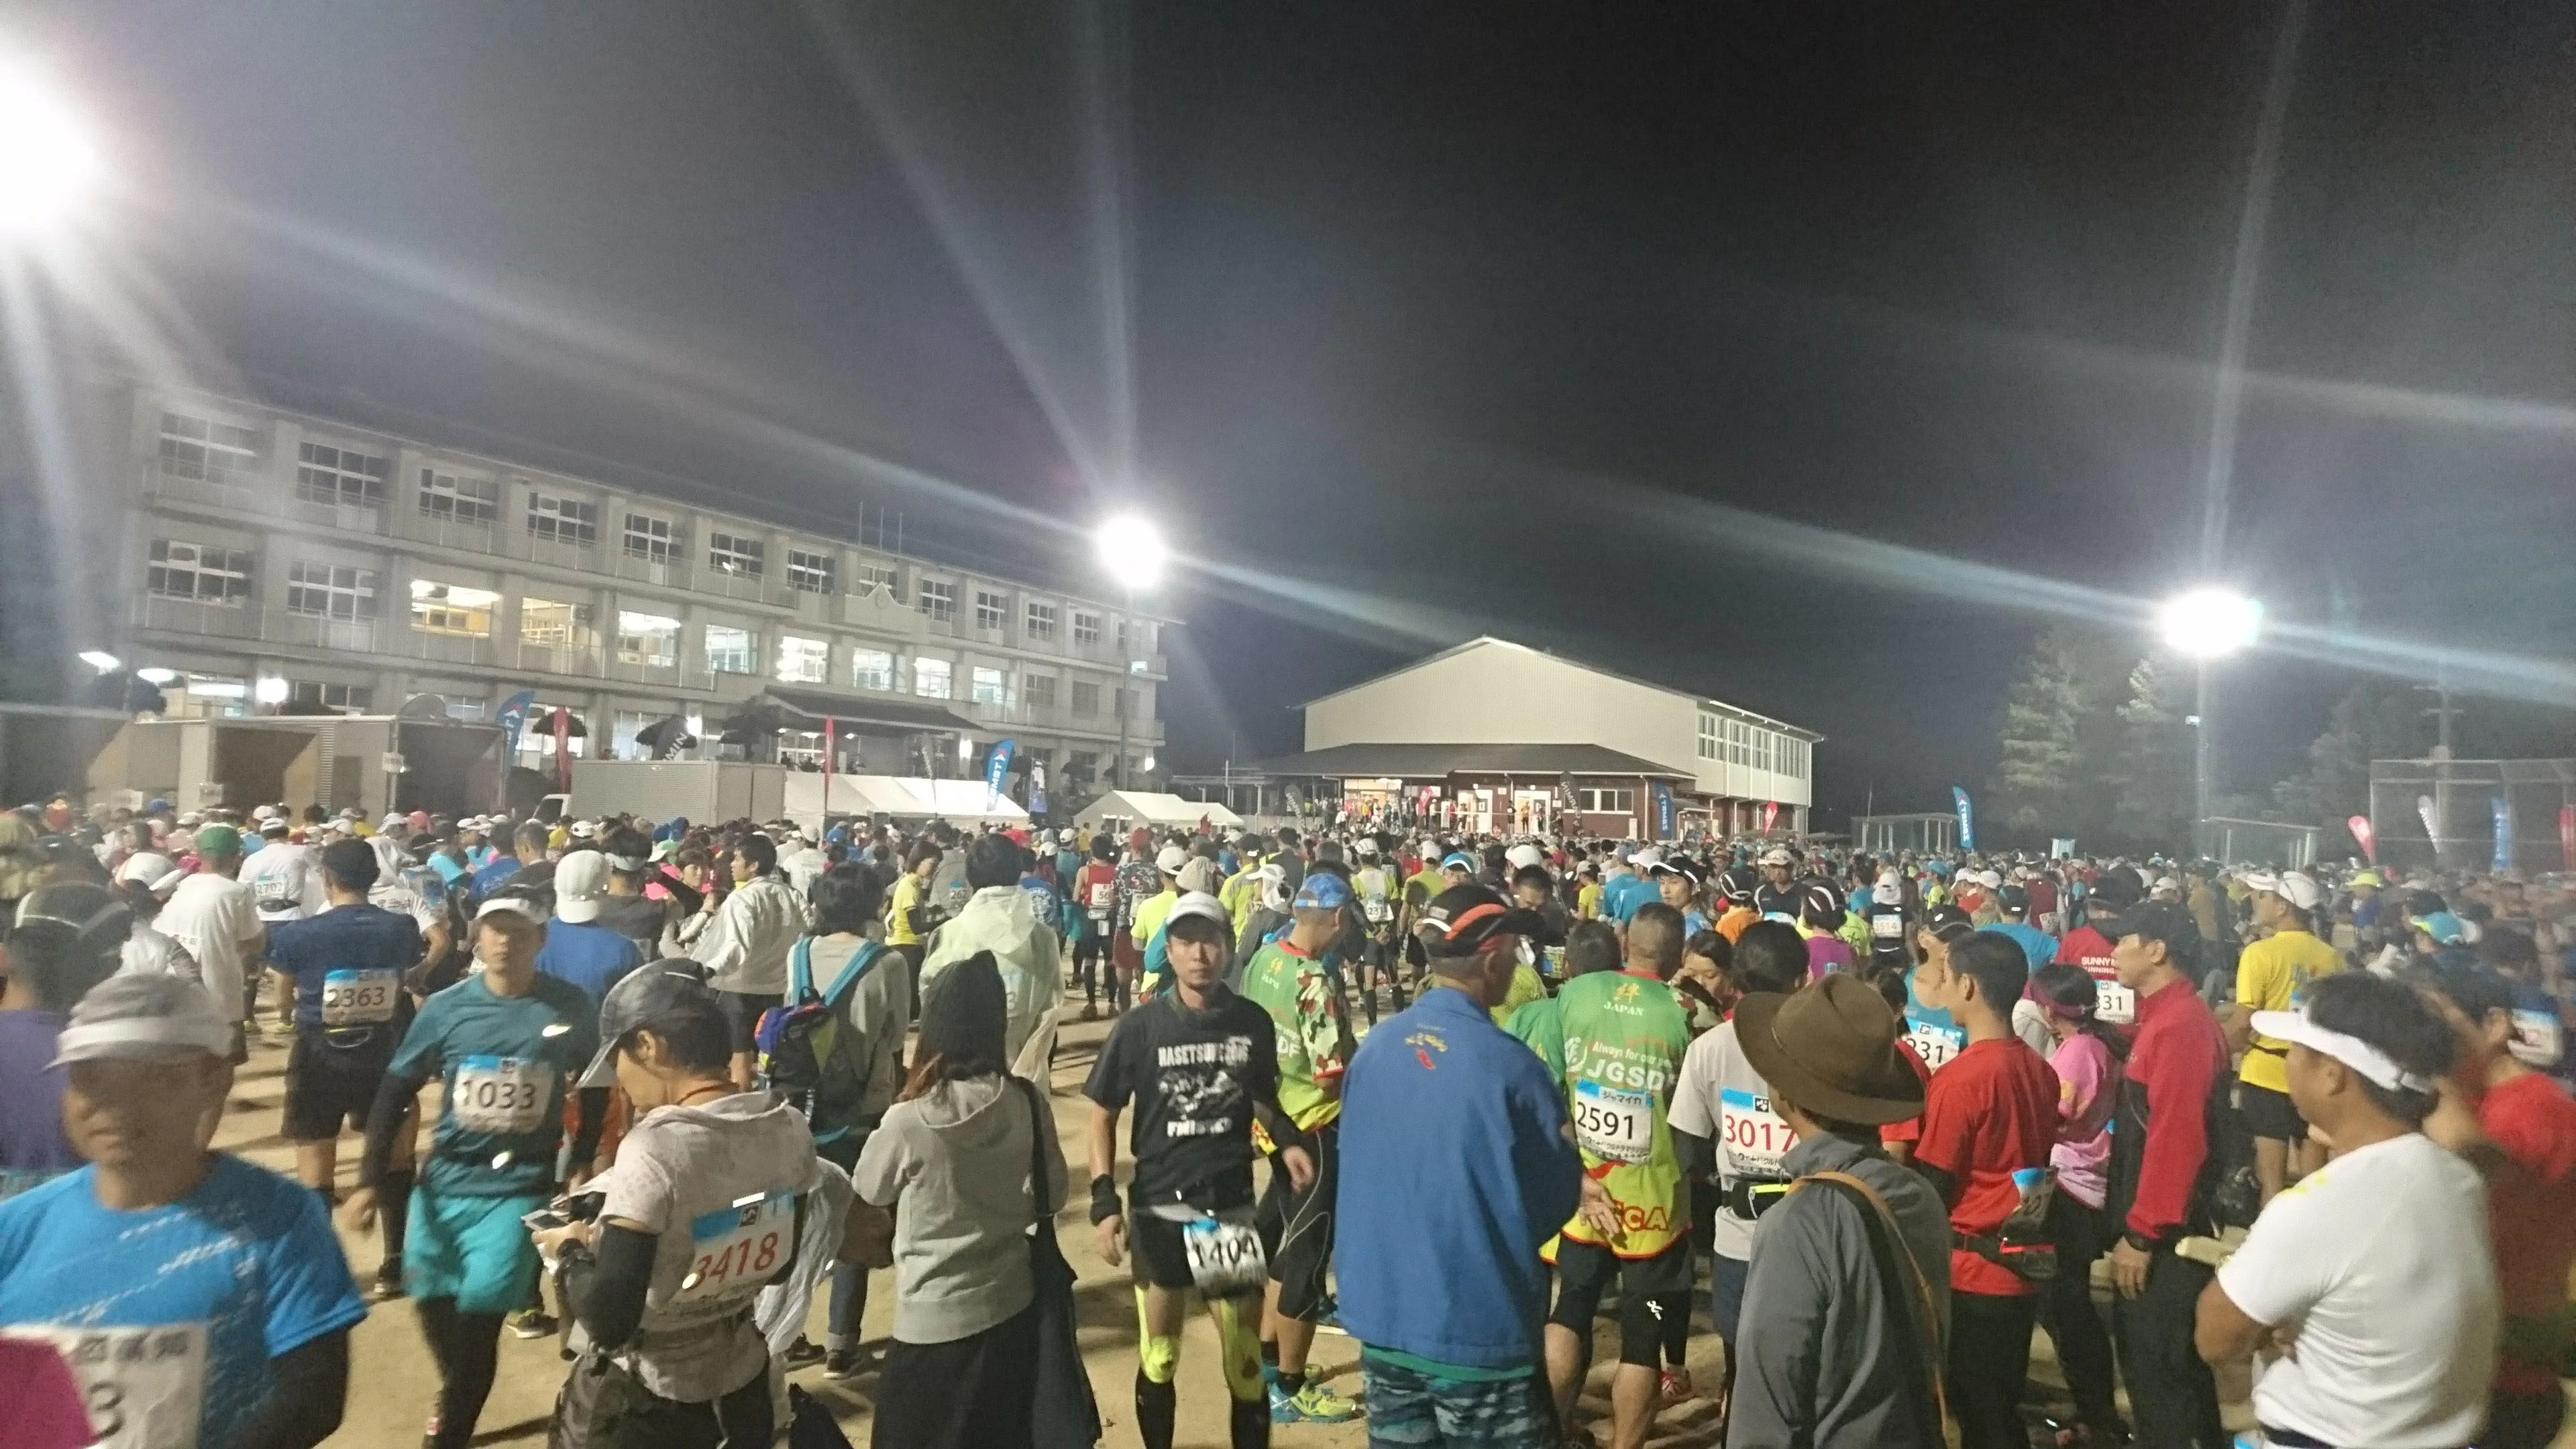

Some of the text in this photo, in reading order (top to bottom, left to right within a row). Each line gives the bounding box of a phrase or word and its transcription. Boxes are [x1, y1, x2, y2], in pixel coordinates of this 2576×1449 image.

[2081, 956, 2110, 966] SUNNY
[326, 986, 385, 1008] 2363
[1603, 1001, 1644, 1016] JAPAN
[1591, 1041, 1623, 1059] Always
[1625, 1048, 1640, 1061] for
[463, 1079, 536, 1110] 1033
[1576, 1101, 1633, 1140] 2591
[1725, 1114, 1796, 1152] 3017
[683, 1232, 779, 1293] 3418
